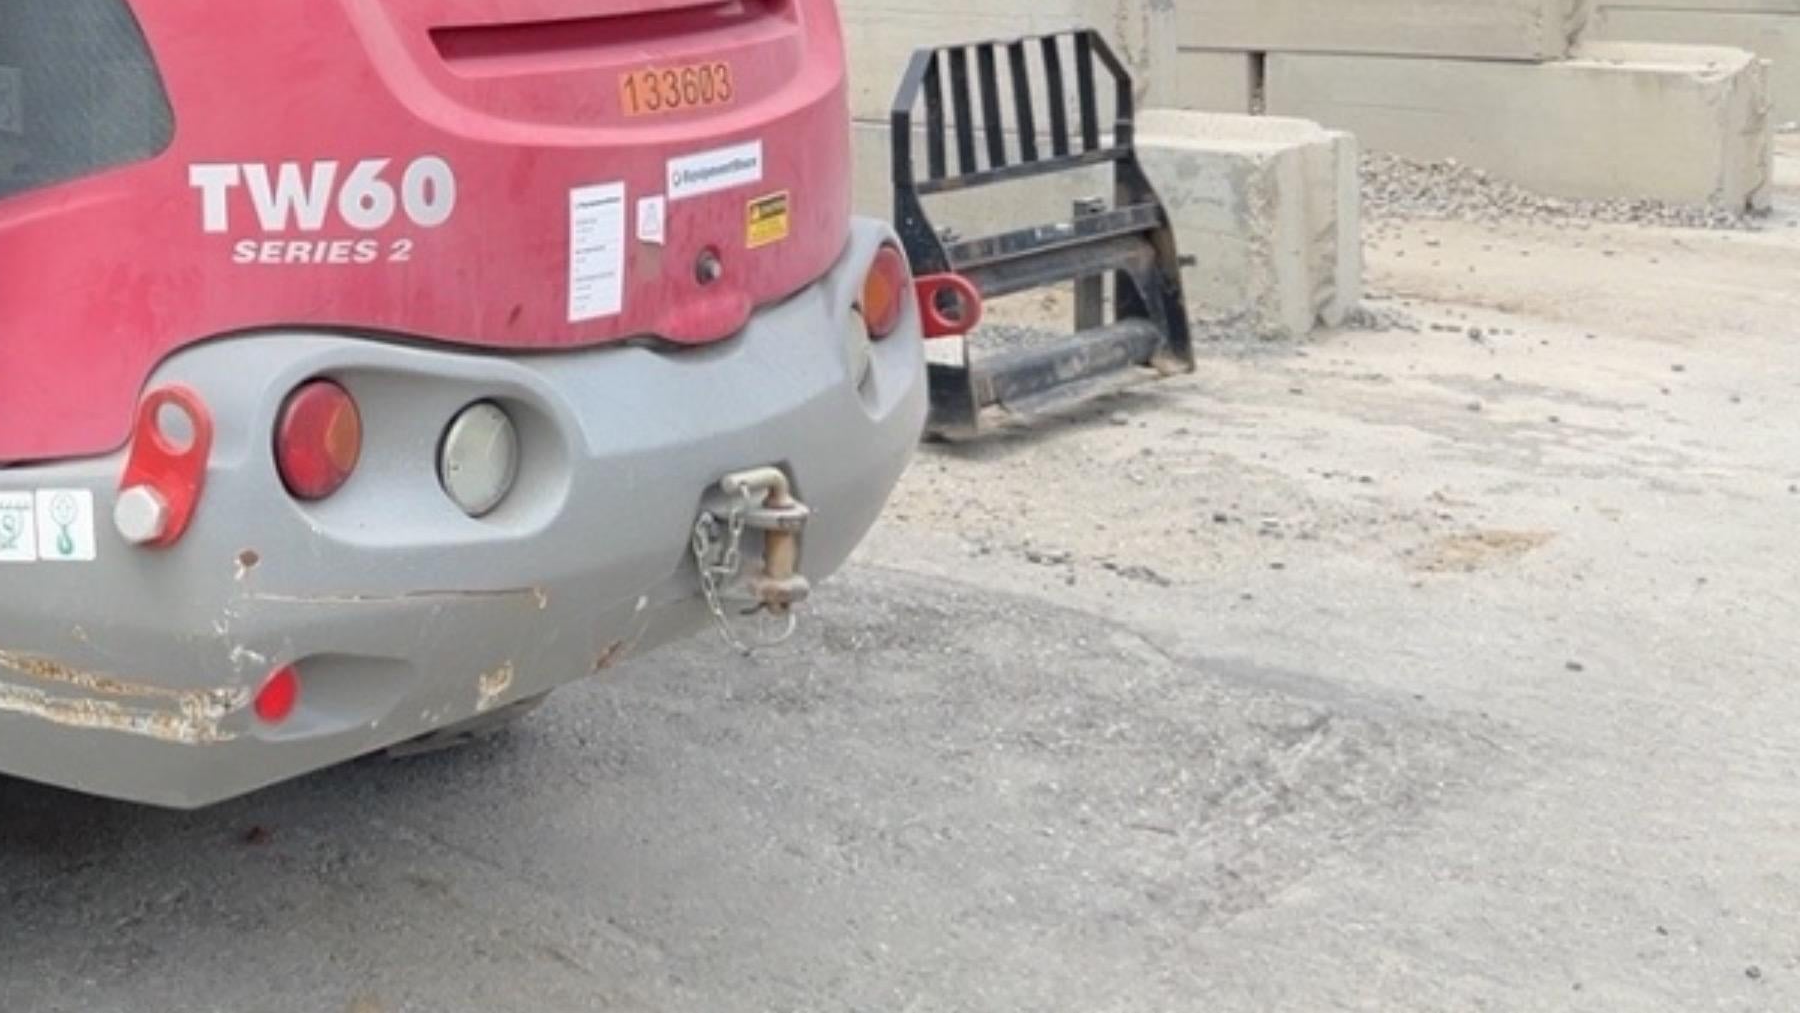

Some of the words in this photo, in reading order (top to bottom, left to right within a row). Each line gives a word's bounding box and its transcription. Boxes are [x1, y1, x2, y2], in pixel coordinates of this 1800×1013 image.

[622, 63, 732, 114] 133603
[188, 155, 457, 233] TW60
[231, 239, 379, 264] SERIES
[387, 238, 414, 263] 2
